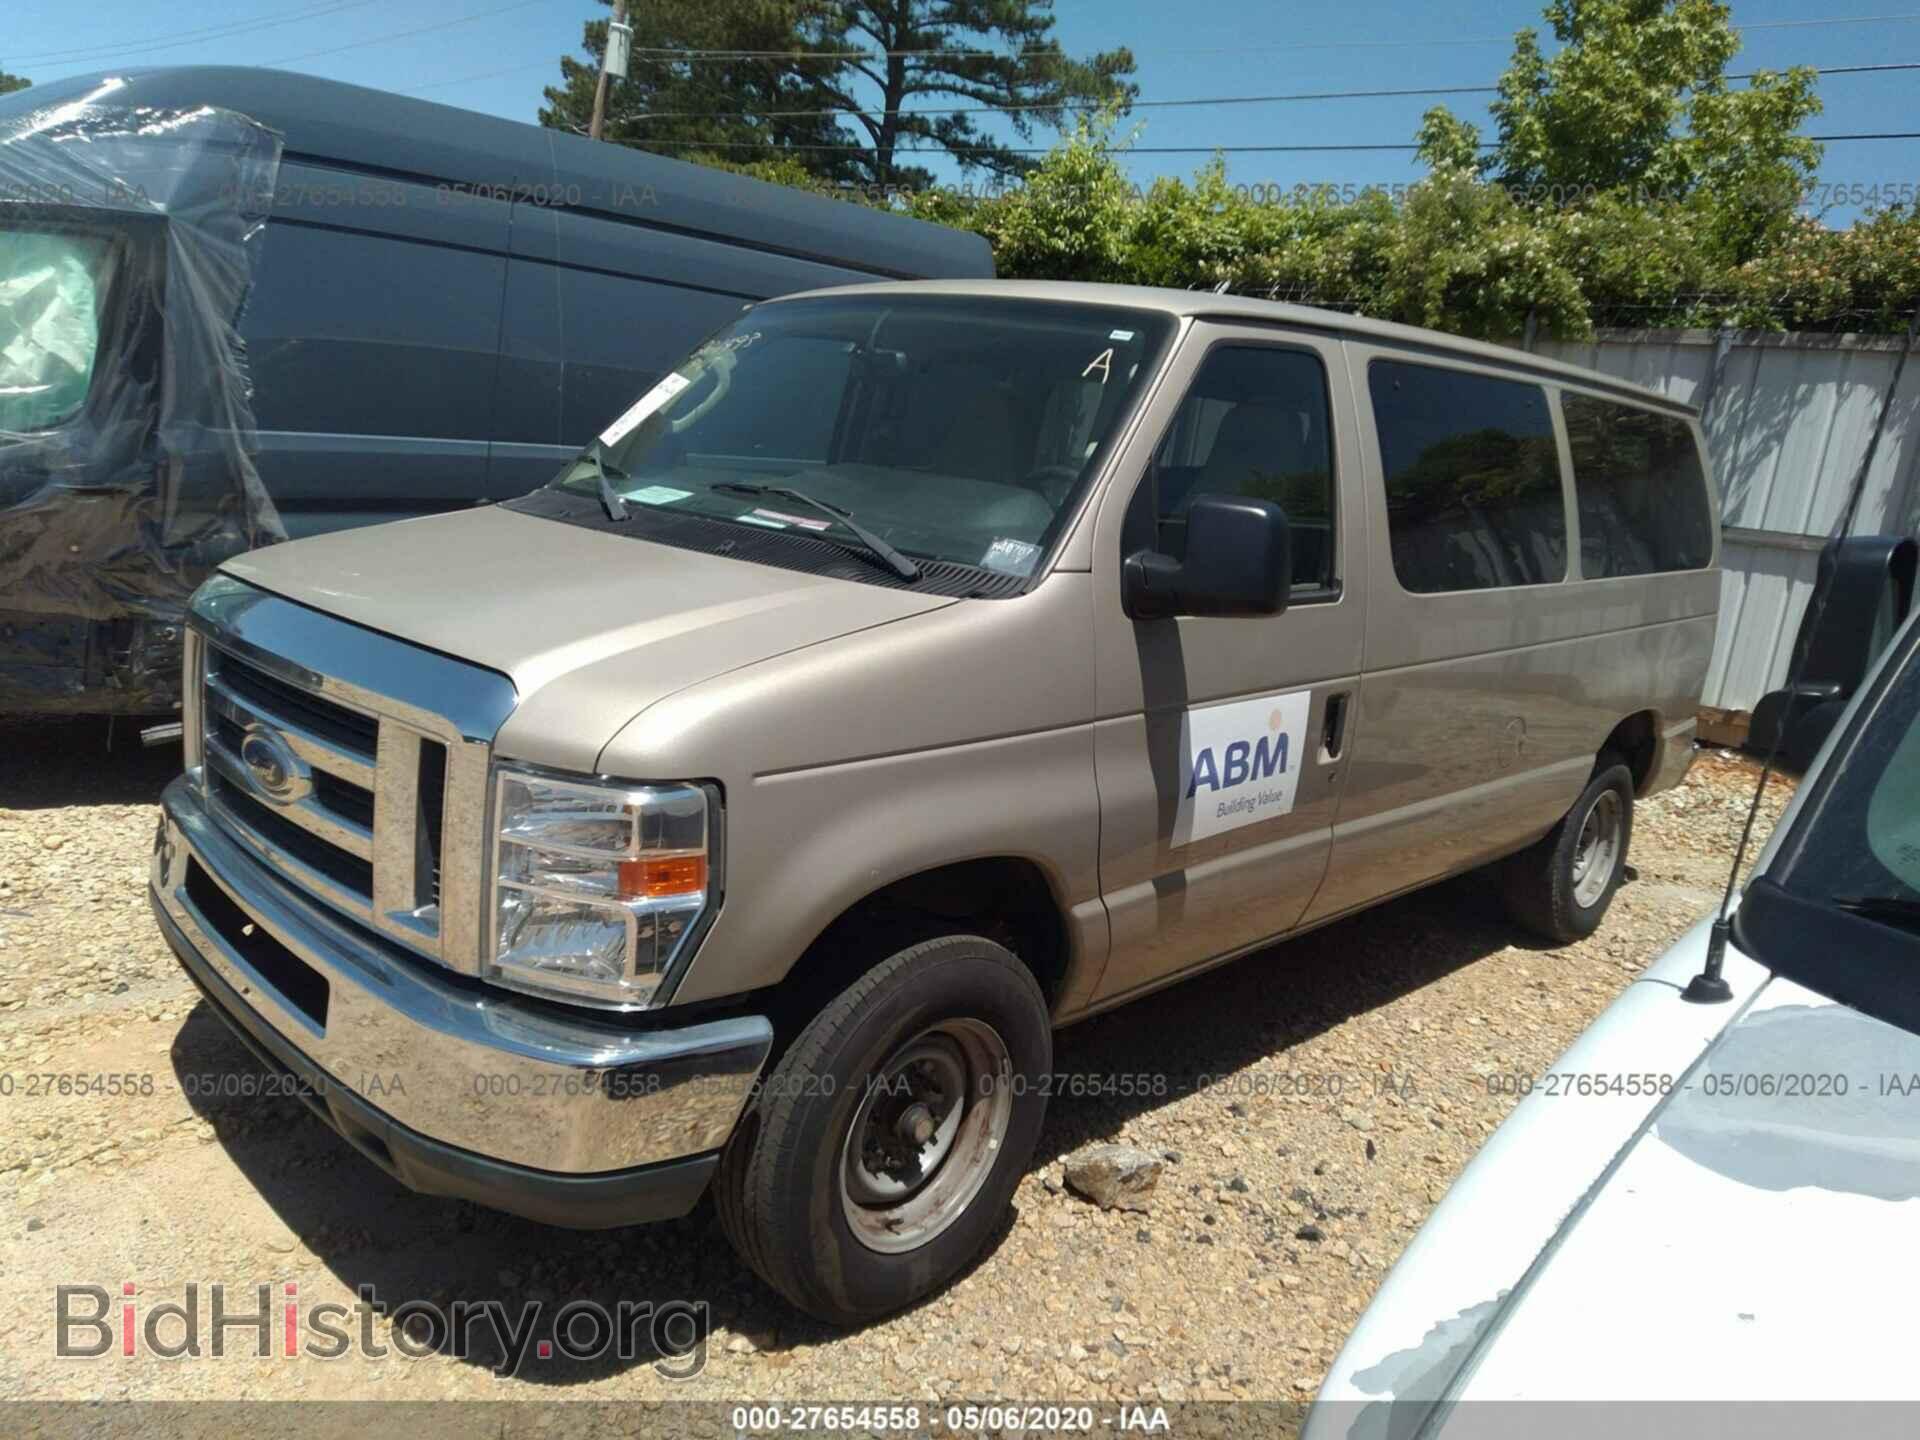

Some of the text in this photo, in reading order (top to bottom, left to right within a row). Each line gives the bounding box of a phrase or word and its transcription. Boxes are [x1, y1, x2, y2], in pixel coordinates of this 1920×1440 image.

[1082, 348, 1114, 385] A
[1186, 732, 1289, 800] ABM
[1215, 788, 1283, 818] Building Value
